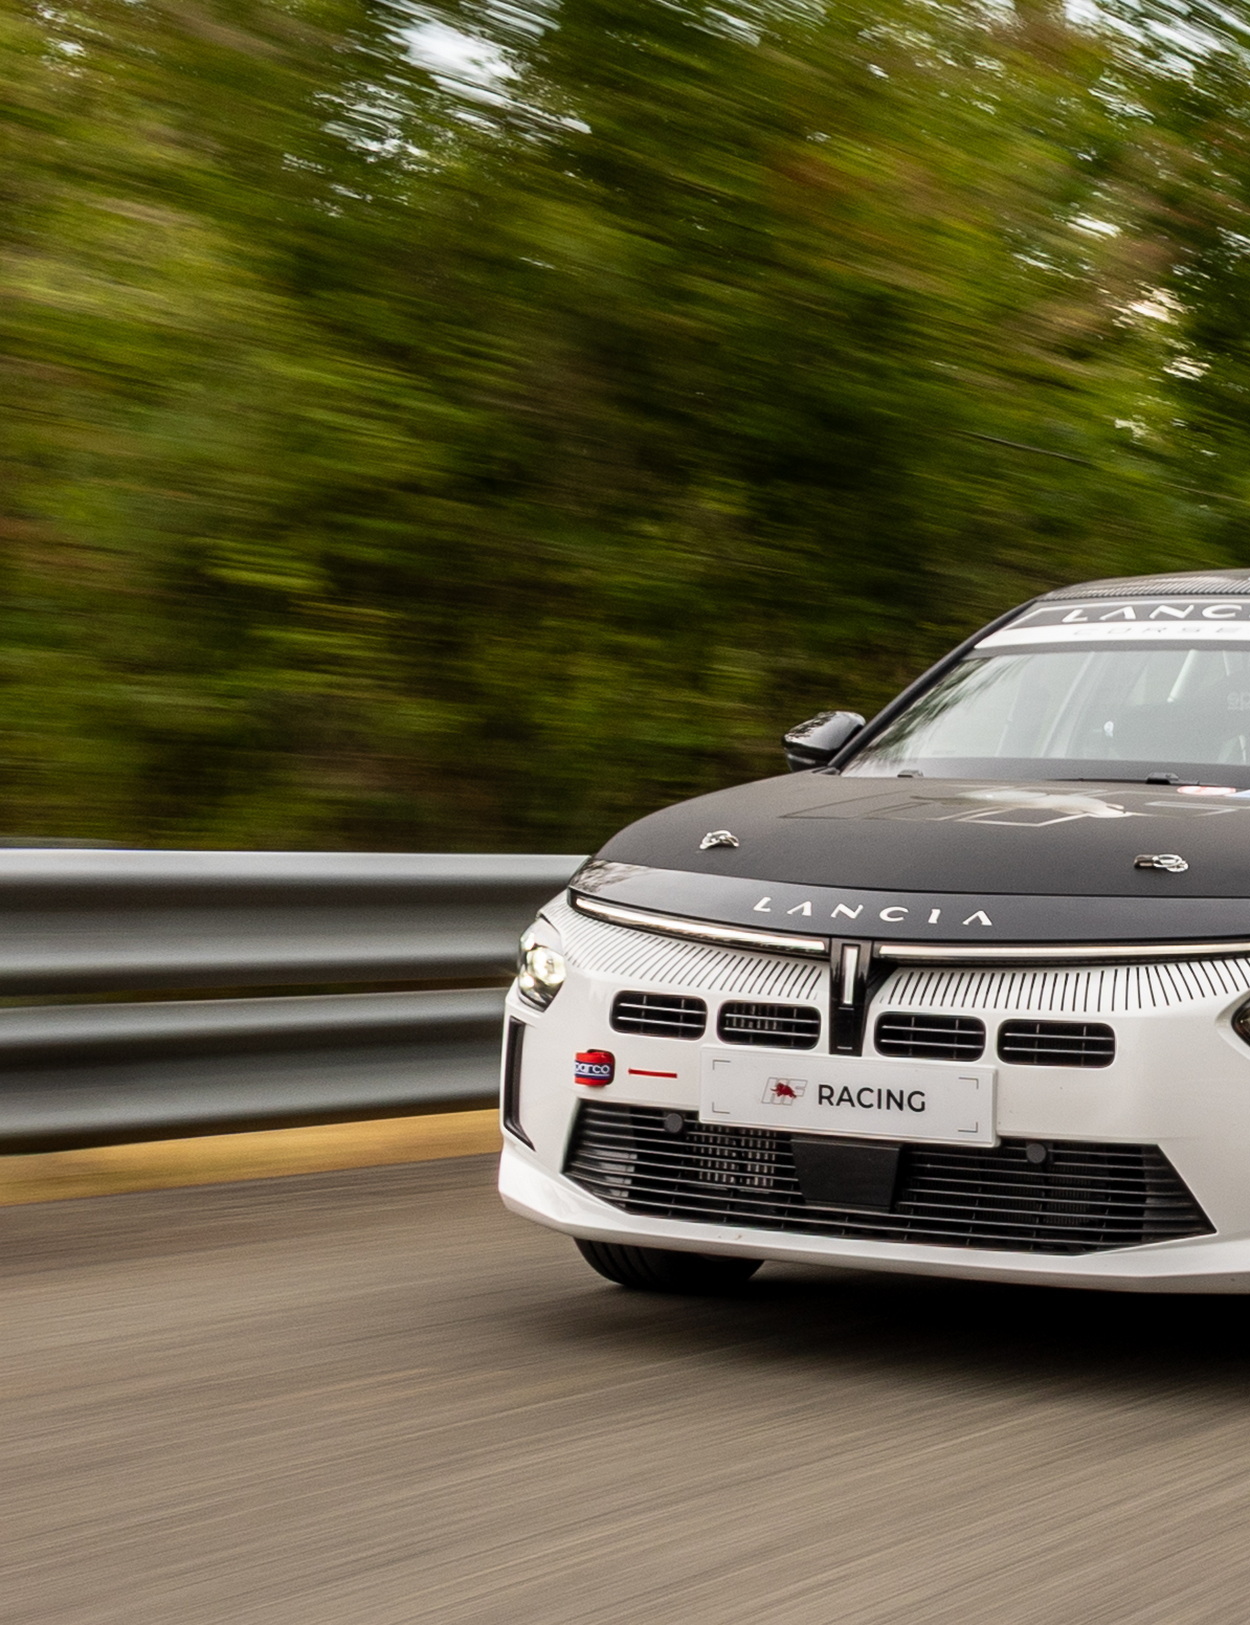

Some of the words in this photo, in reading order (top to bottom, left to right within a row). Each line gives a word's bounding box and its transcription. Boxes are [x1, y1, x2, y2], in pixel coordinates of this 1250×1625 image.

[753, 896, 993, 926] LANCIA
[574, 1061, 610, 1077] parco
[818, 1084, 926, 1112] RACING
